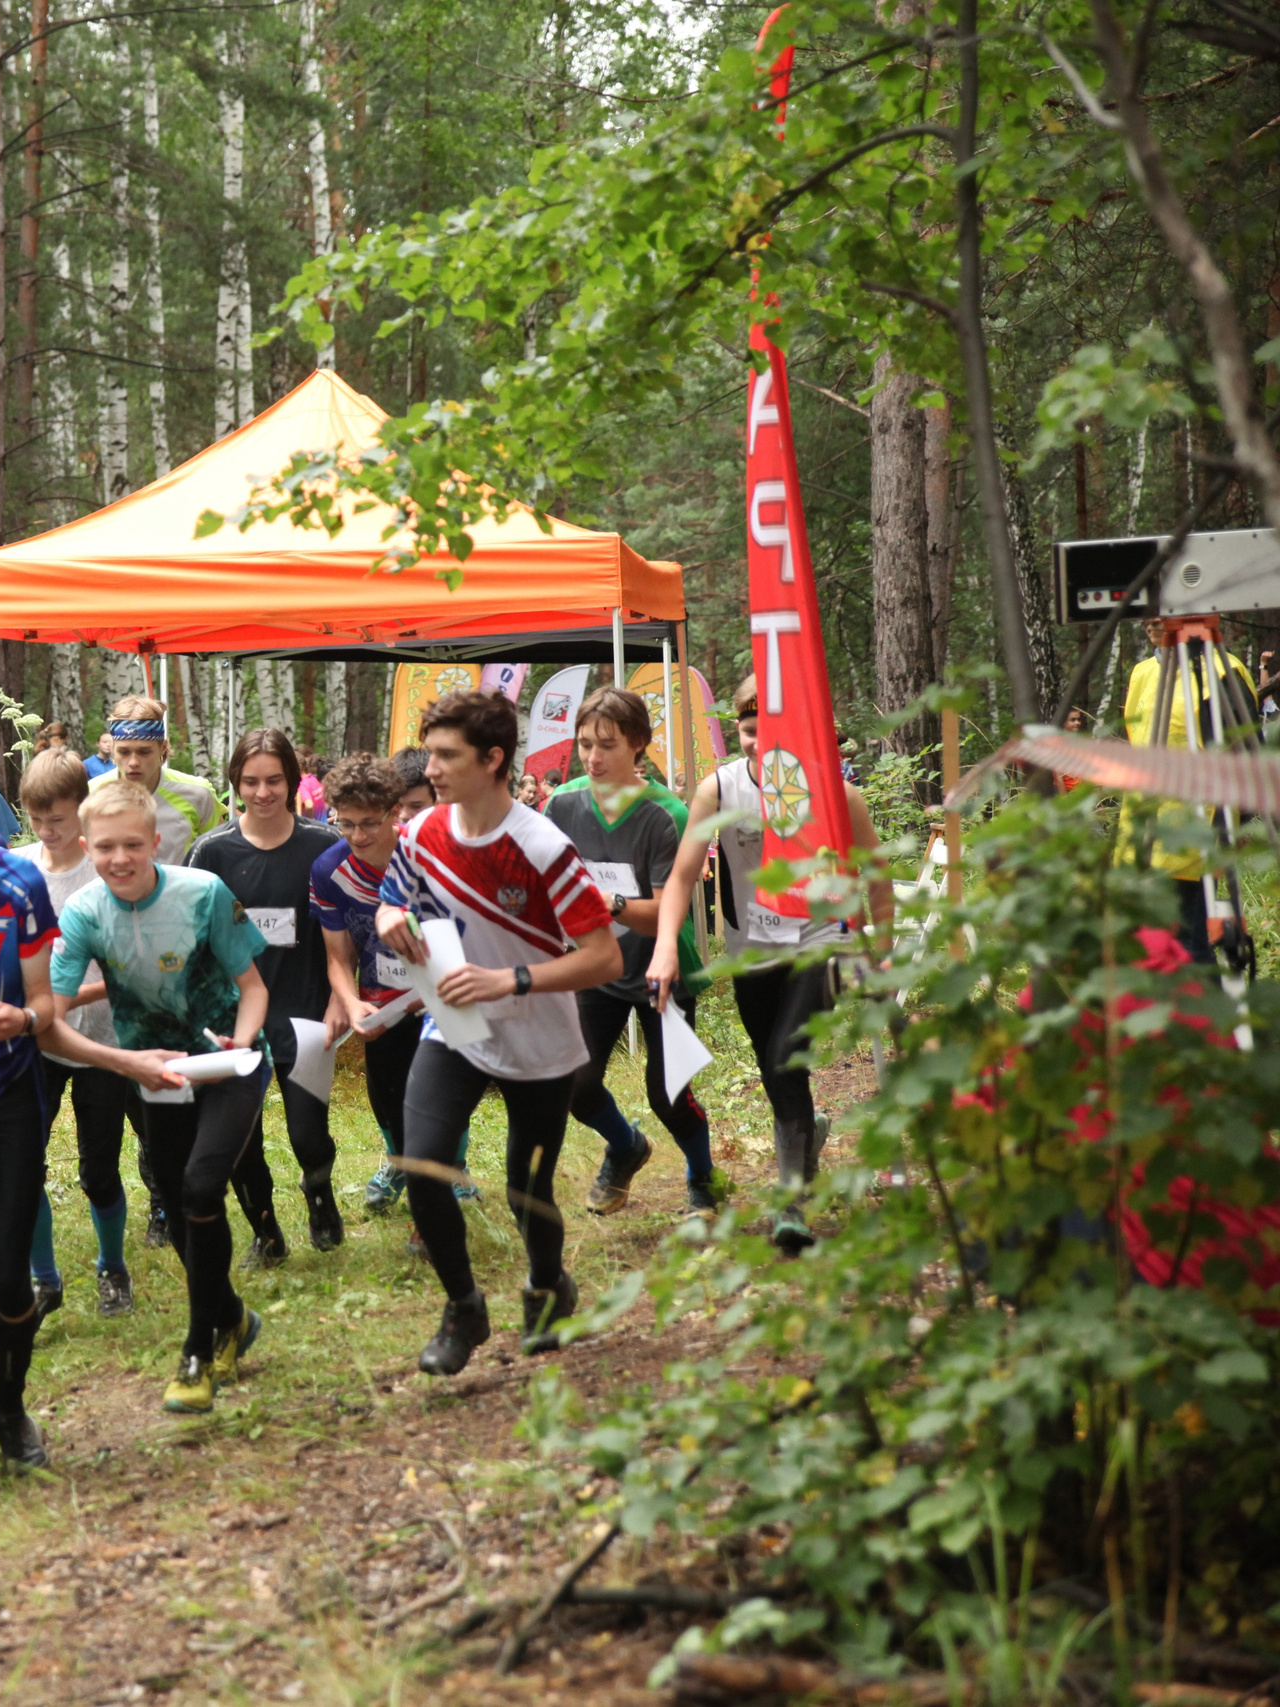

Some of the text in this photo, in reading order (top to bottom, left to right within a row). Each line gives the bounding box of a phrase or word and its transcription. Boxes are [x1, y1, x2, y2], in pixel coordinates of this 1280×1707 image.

[597, 870, 618, 881] 149
[256, 917, 279, 929] 147
[757, 913, 781, 926] 150
[385, 965, 407, 977] 148
